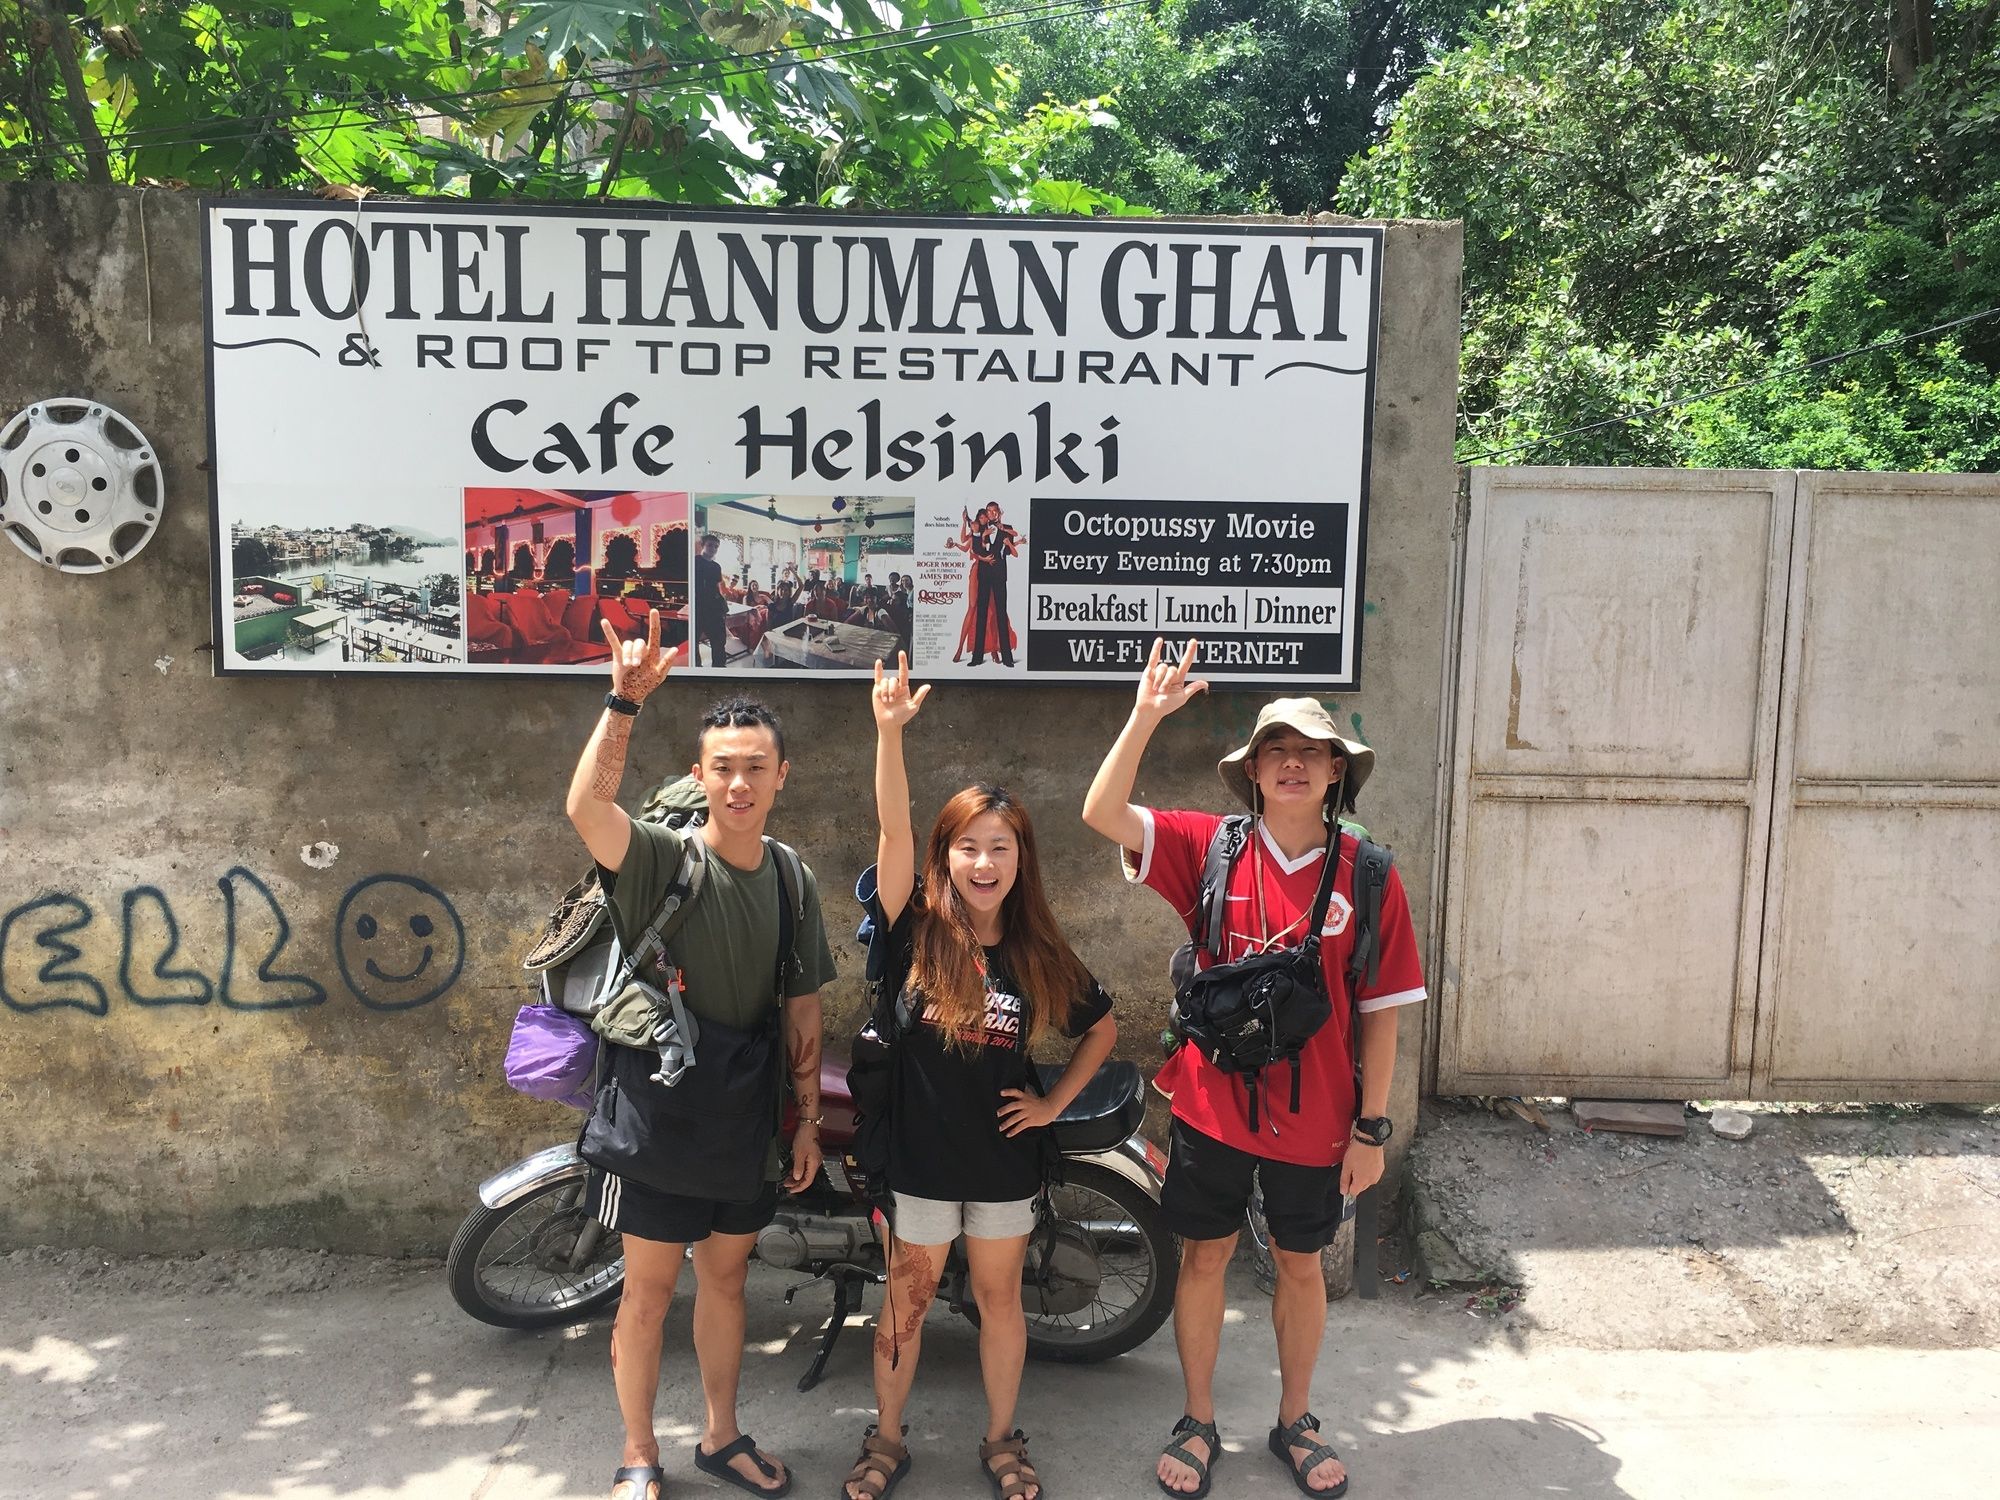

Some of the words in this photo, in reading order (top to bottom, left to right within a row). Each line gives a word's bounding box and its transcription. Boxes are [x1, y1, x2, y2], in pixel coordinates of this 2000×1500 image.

[222, 218, 555, 324] HOTEL
[576, 226, 1079, 338] HANUMAN
[1100, 239, 1364, 342] GHAT
[338, 332, 383, 369] &
[416, 334, 611, 373] ROOF
[635, 340, 771, 377] TOP
[804, 345, 1255, 387] RESTAURANT
[470, 391, 675, 477] Cafe
[734, 398, 1121, 485] Helsinki
[1063, 510, 1216, 543] Octopussy
[1226, 513, 1315, 540] Movie
[940, 561, 966, 569] MOORE
[1043, 550, 1109, 575] Every
[1117, 551, 1211, 577] Evening
[1219, 554, 1242, 573] at
[1250, 553, 1332, 578] 7:30pm
[1036, 592, 1149, 624] Breakfast
[1164, 594, 1238, 625] Lunch
[1254, 595, 1337, 626] Dinner
[1067, 638, 1144, 664] Wi-Fi
[1152, 638, 1304, 666] NTERNET
[983, 1012, 1020, 1034] RAC
